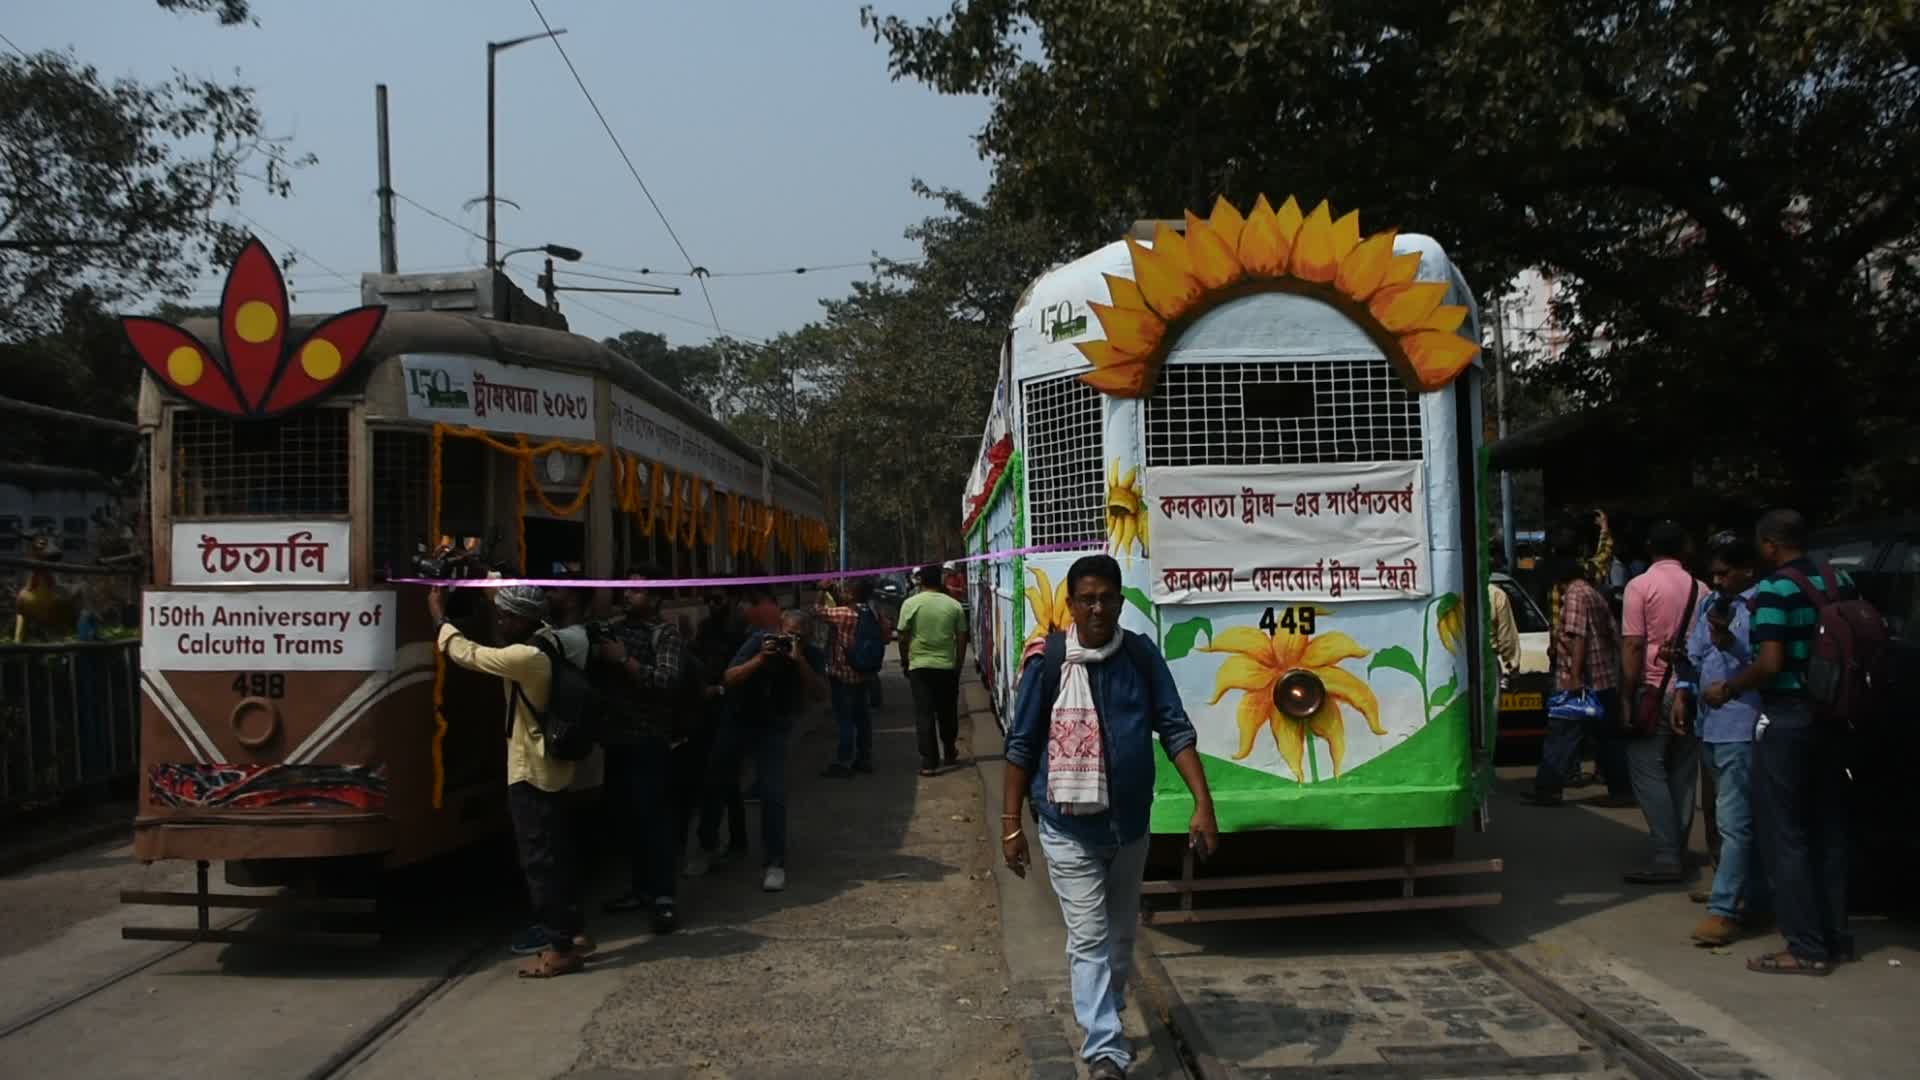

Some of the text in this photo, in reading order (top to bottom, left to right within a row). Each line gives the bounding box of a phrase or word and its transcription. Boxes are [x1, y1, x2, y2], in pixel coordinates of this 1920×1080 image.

[543, 390, 588, 420] ২০২৩
[1160, 495, 1235, 519] কলকাতা
[1325, 482, 1414, 514] সার্ধশতবর্ষ
[197, 531, 329, 573] চৈতালি
[149, 604, 383, 632] 150th Anniversary of
[1259, 606, 1316, 636] 449
[177, 632, 343, 654] Calcutta Trams
[231, 671, 286, 699] 498
